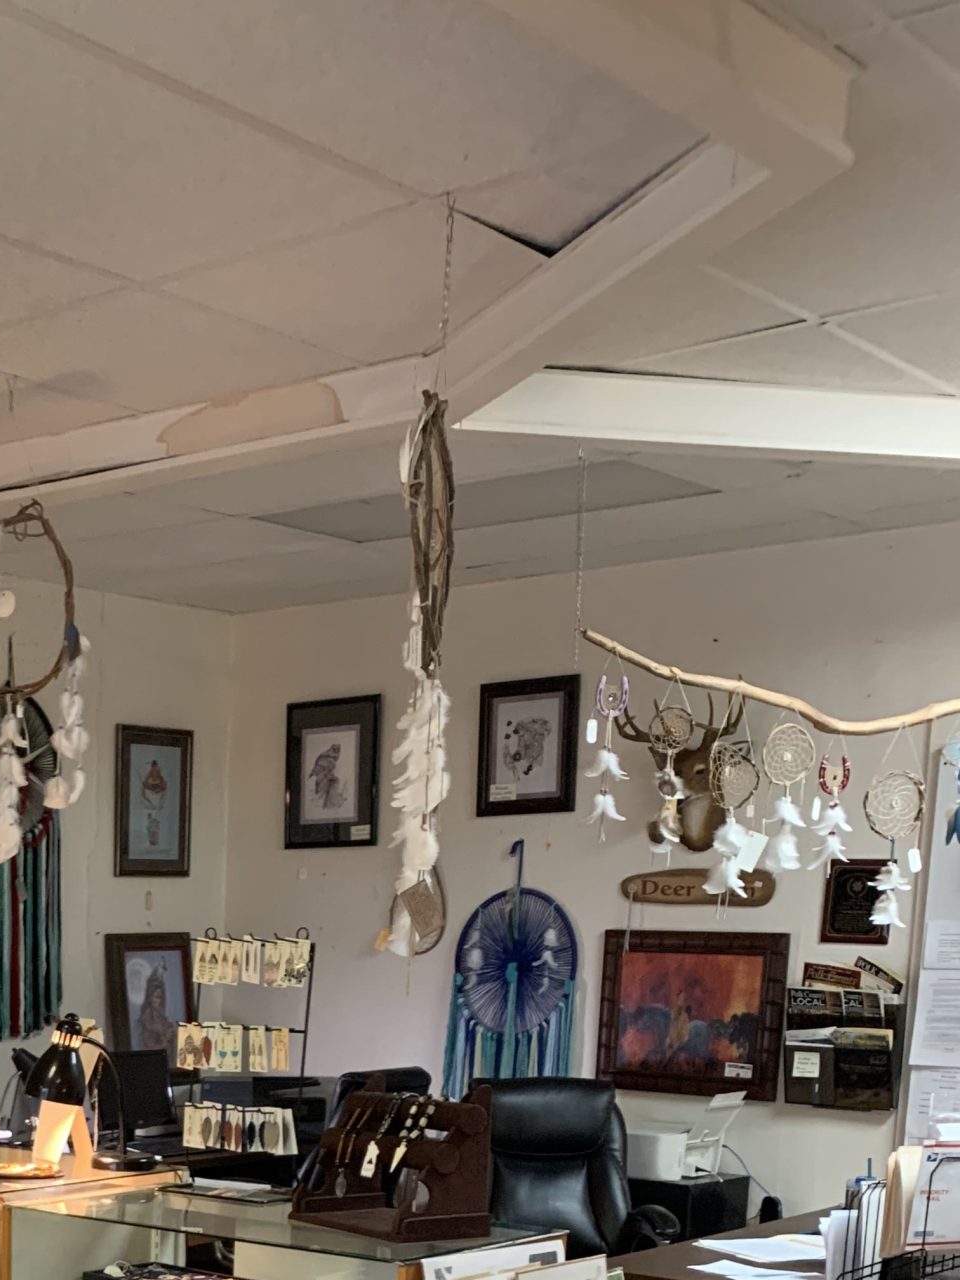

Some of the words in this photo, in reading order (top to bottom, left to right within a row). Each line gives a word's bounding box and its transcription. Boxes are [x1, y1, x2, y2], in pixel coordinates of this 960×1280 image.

[642, 879, 696, 897] Deer
[791, 997, 826, 1007] LOCAL
[843, 1000, 863, 1008] CAL
